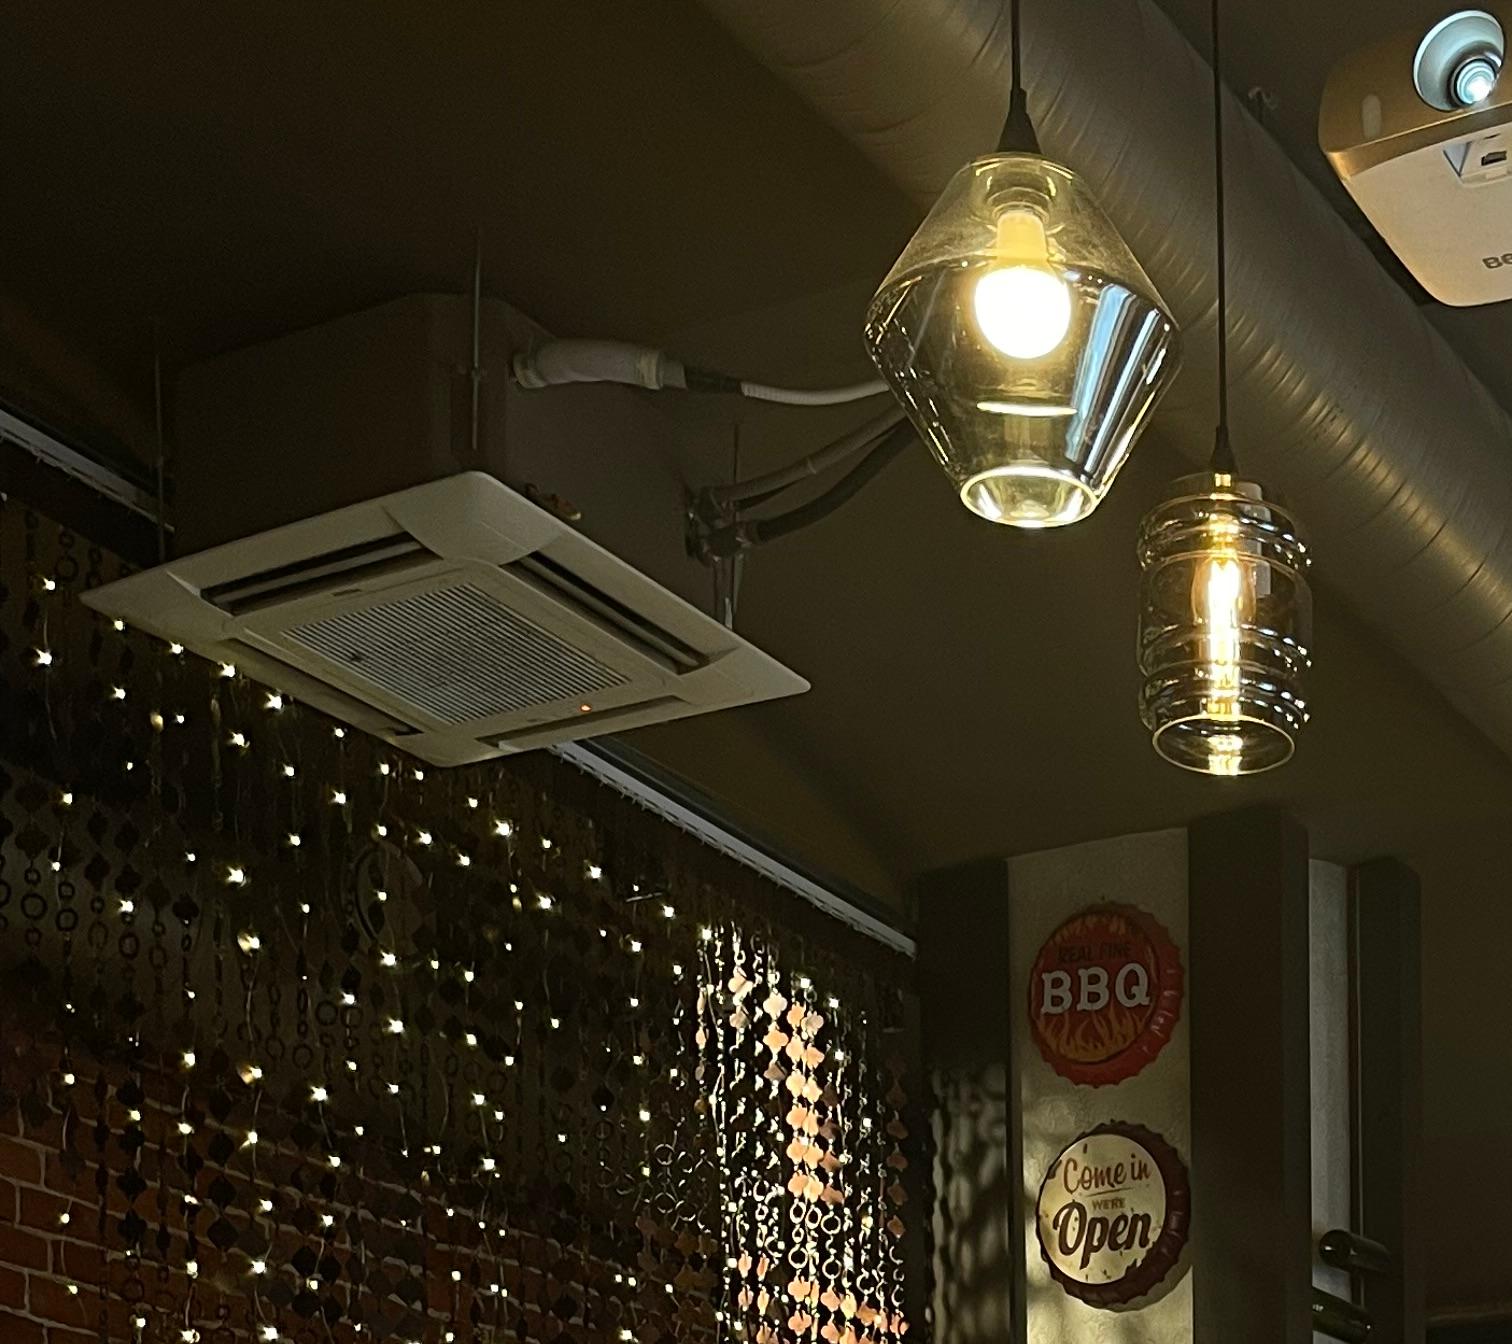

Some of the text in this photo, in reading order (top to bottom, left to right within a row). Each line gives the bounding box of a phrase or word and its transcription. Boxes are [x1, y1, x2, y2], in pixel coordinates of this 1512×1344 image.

[1040, 962, 1151, 1015] BBQ
[1063, 1153, 1151, 1194] Come in
[1052, 1201, 1152, 1270] Open
